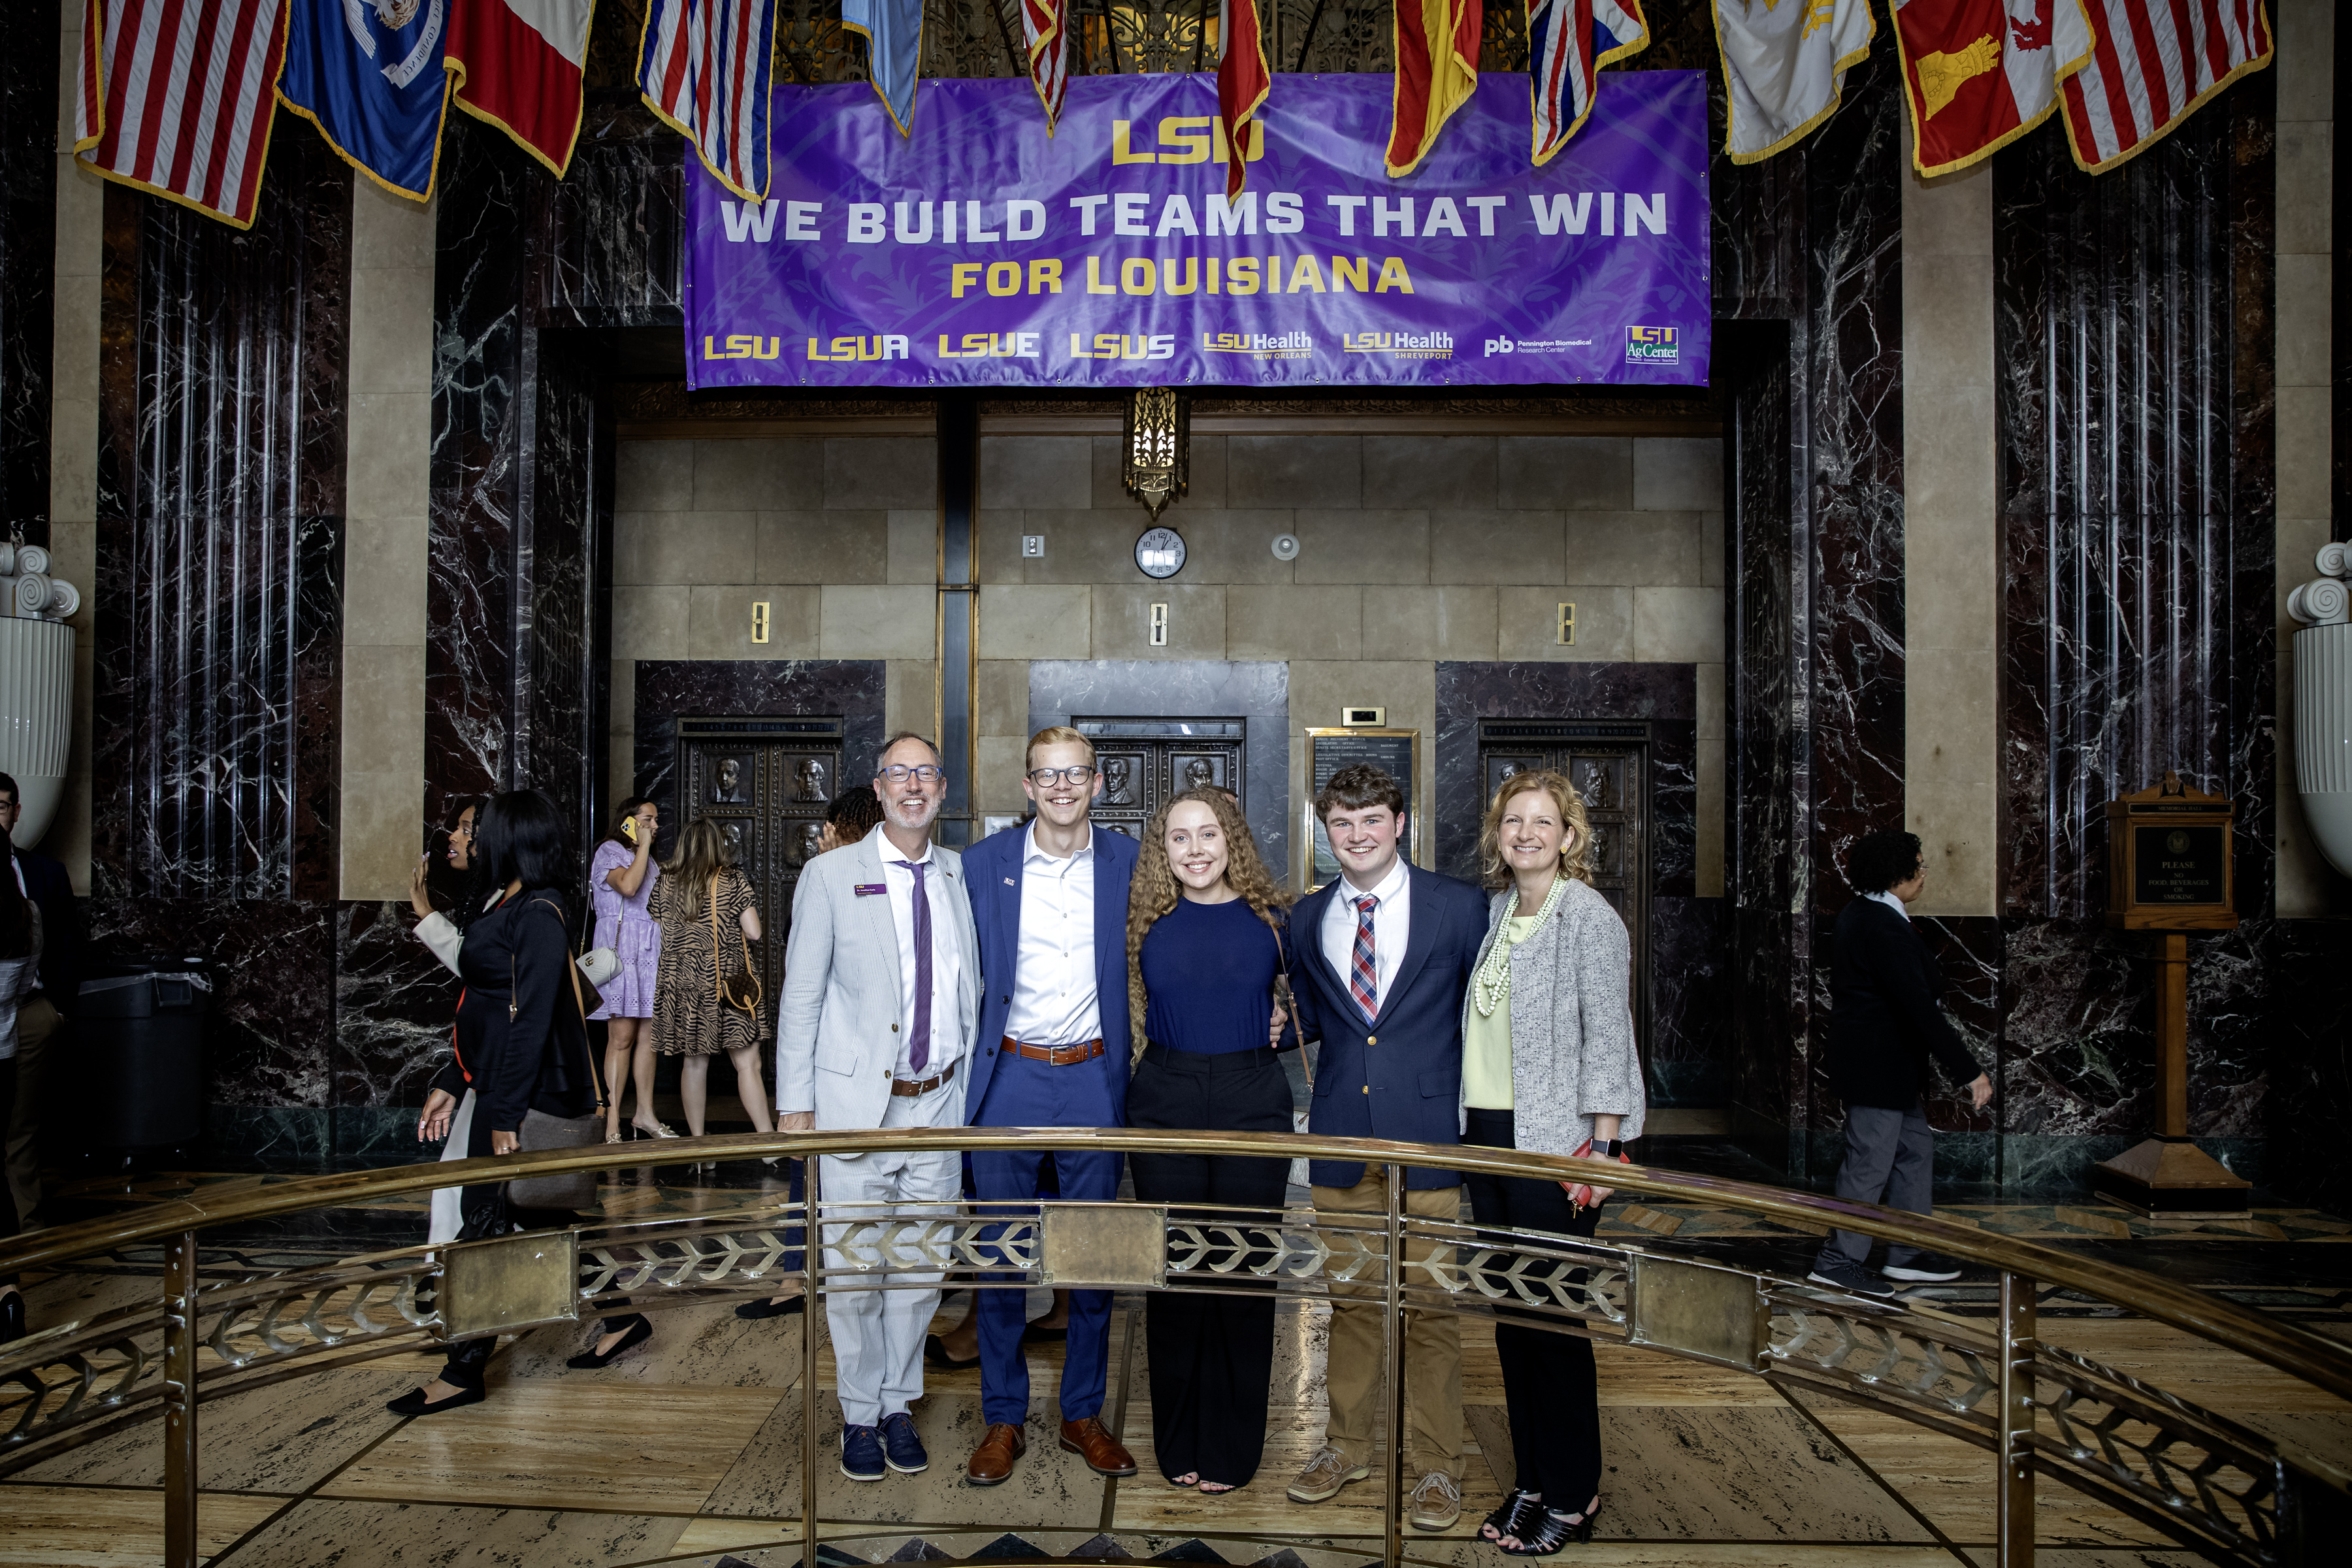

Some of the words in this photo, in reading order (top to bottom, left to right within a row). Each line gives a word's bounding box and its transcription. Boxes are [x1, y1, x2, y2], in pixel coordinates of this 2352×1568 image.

[1113, 116, 1264, 166] LSU
[720, 199, 823, 242] WE
[847, 199, 1047, 244] BUILD
[1070, 191, 1305, 237] TEAMS
[1328, 195, 1506, 237] THAT
[1529, 192, 1667, 237] WIN
[951, 258, 1063, 299] FOR
[1086, 255, 1414, 296] LOUISIANA
[704, 335, 779, 360] LSU
[808, 335, 909, 361] LSUA
[939, 332, 1039, 358] LSUE
[1070, 333, 1175, 359] LSUS
[1203, 333, 1250, 350] LSU
[1253, 331, 1312, 350] Health
[1344, 333, 1391, 349] LSU
[1395, 332, 1453, 349] Health
[1484, 335, 1514, 357] pb
[1627, 327, 1677, 345] LSU
[1253, 352, 1272, 361] NEW
[1274, 351, 1311, 360] ORLEANS
